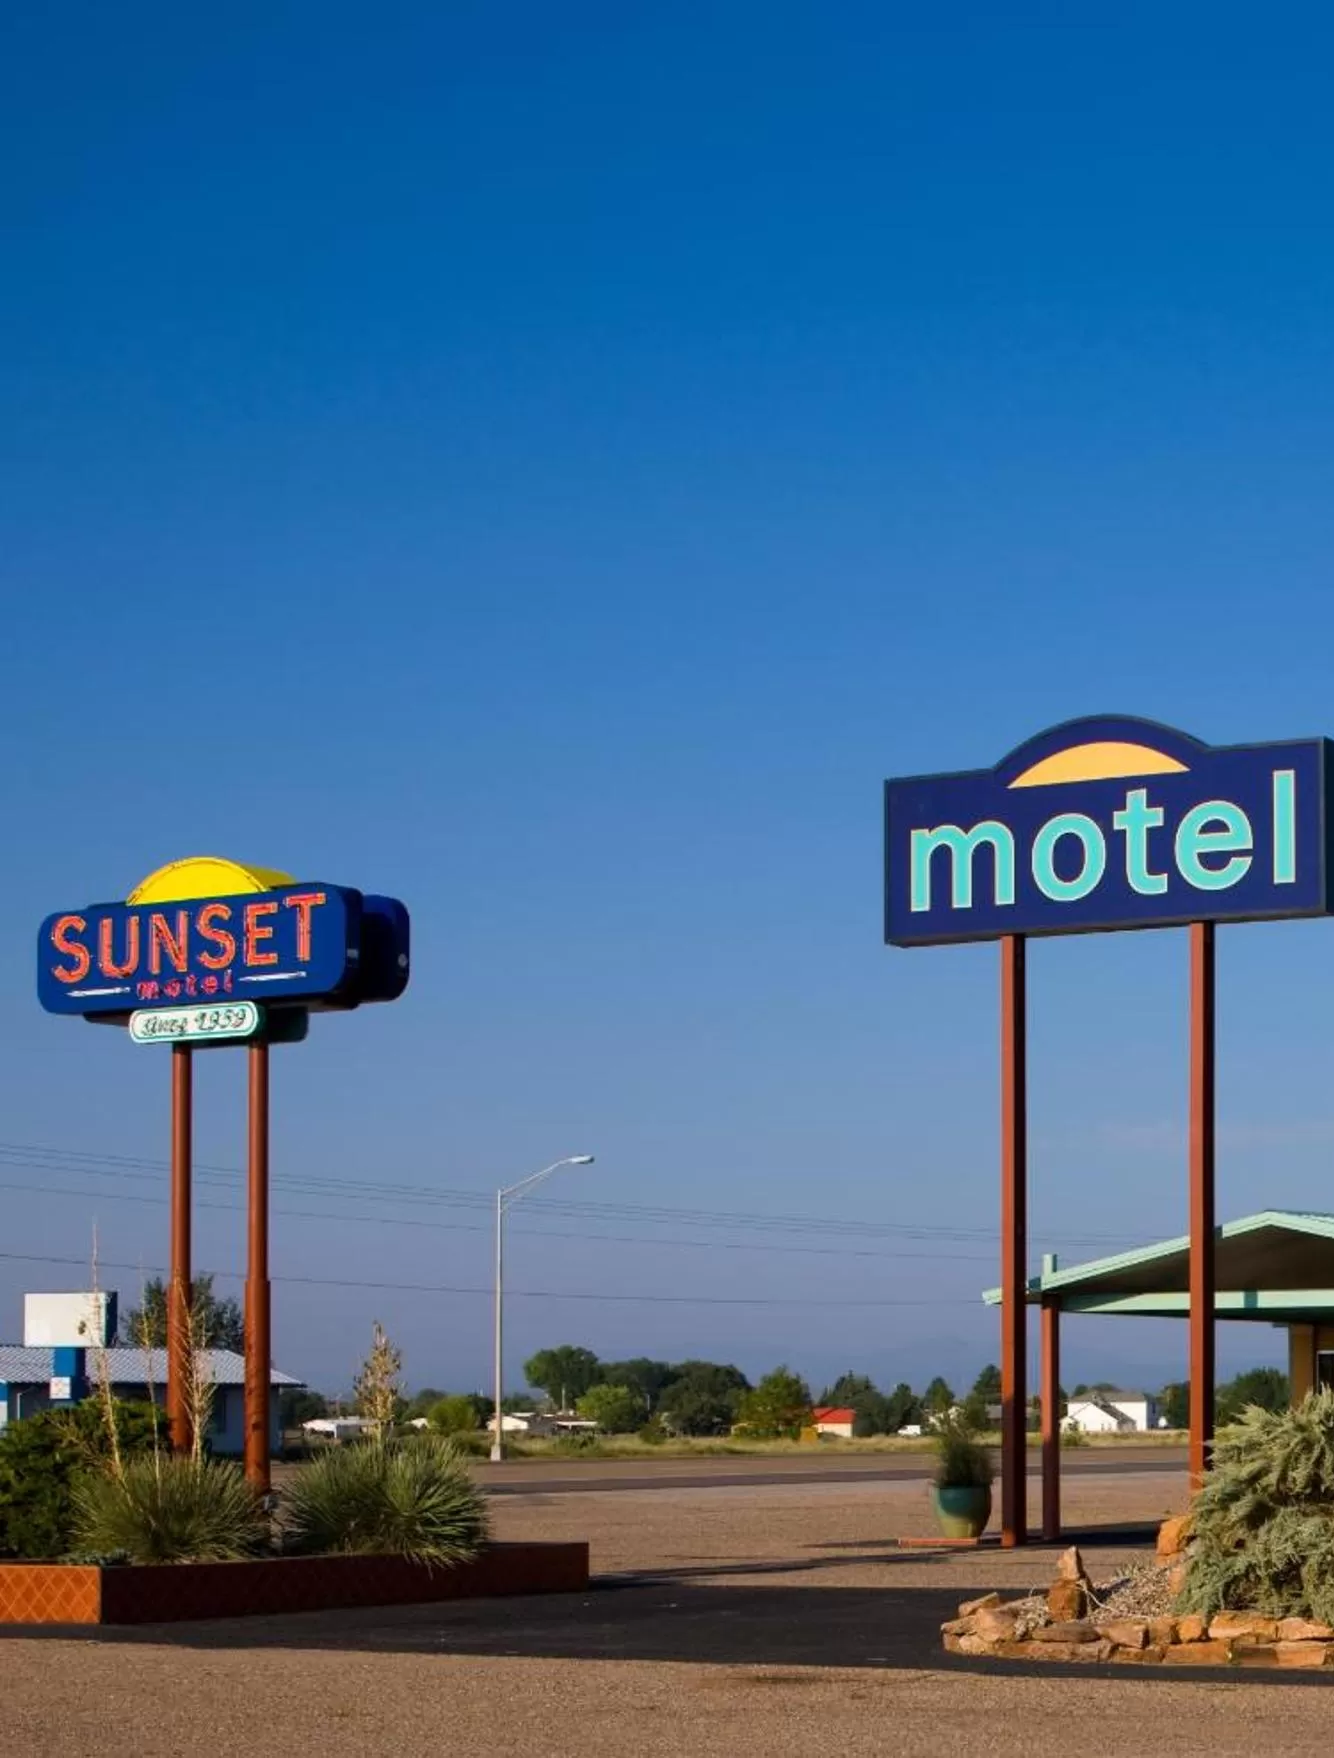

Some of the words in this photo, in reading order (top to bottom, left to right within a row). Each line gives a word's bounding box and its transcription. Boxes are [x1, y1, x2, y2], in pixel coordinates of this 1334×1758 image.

[911, 769, 1296, 912] motel
[52, 893, 326, 984] SUNSET
[136, 969, 233, 1000] motel
